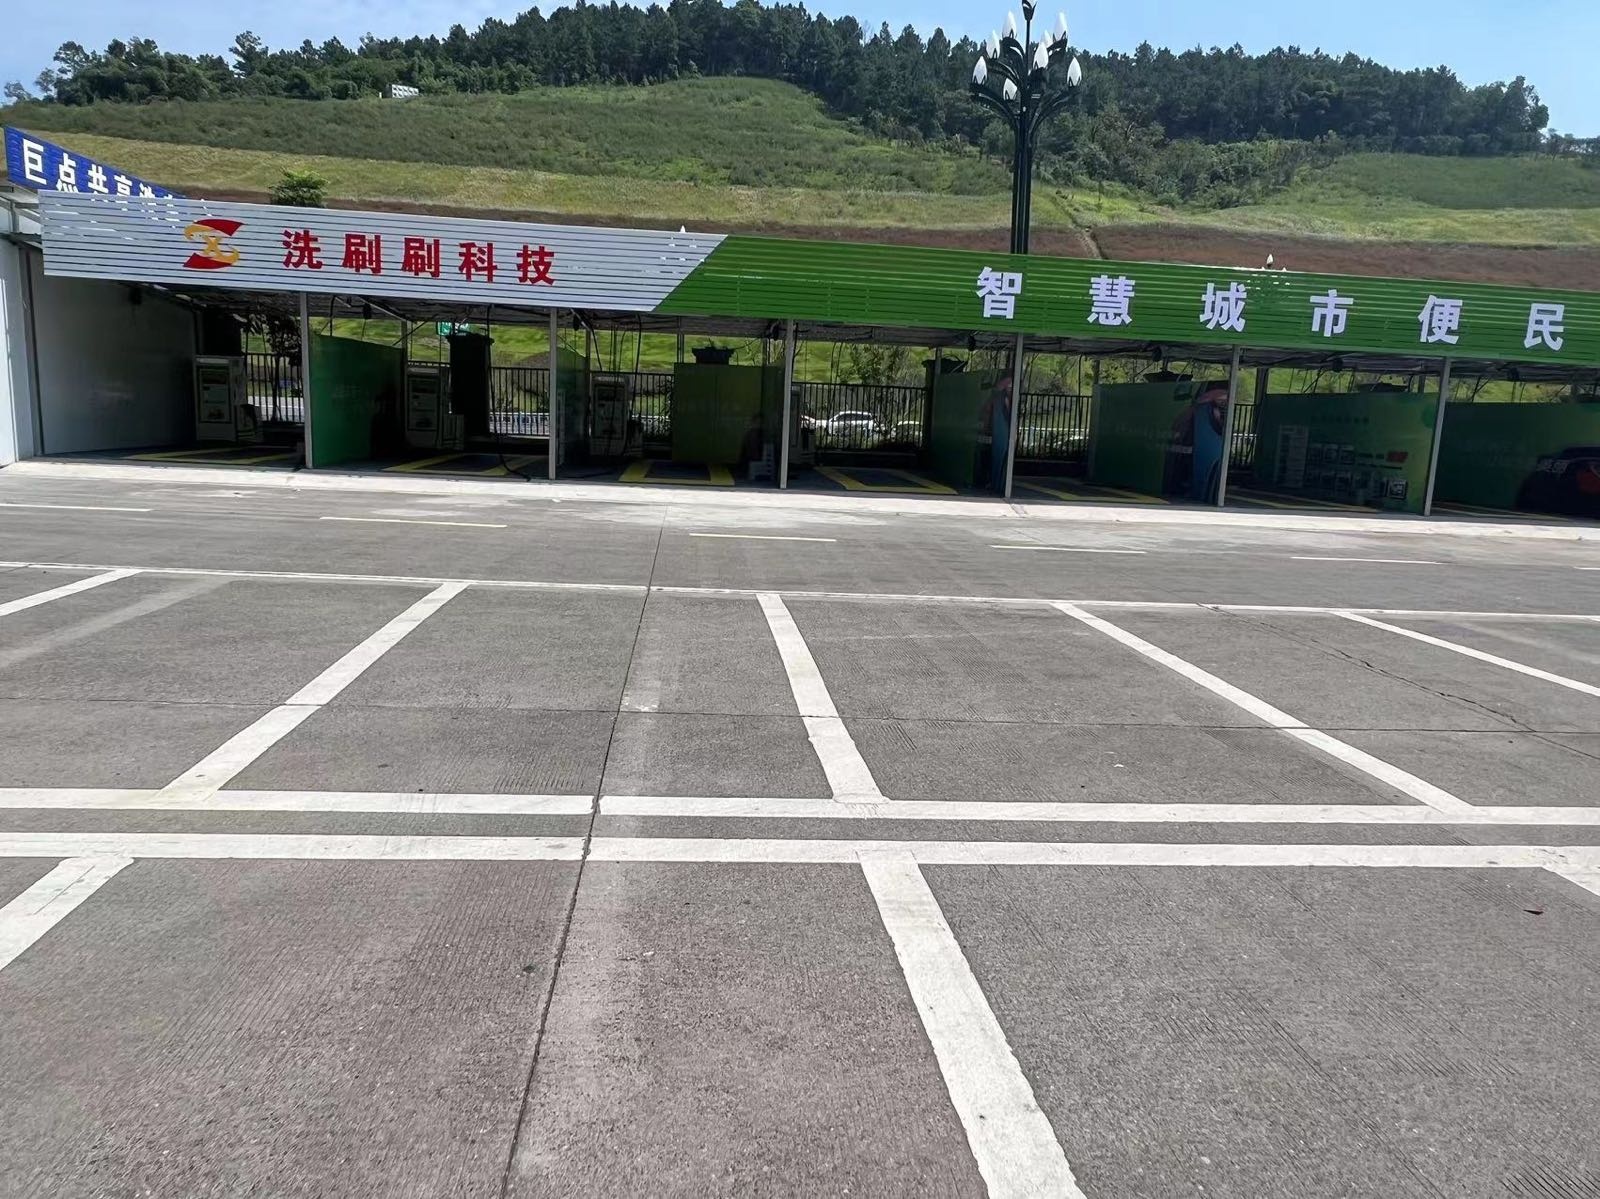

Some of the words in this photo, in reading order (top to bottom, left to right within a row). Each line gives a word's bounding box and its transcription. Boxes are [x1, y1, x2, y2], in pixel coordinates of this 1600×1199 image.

[283, 229, 555, 286] 洗刷刷科技
[976, 266, 1565, 350] 智慧城市便民
